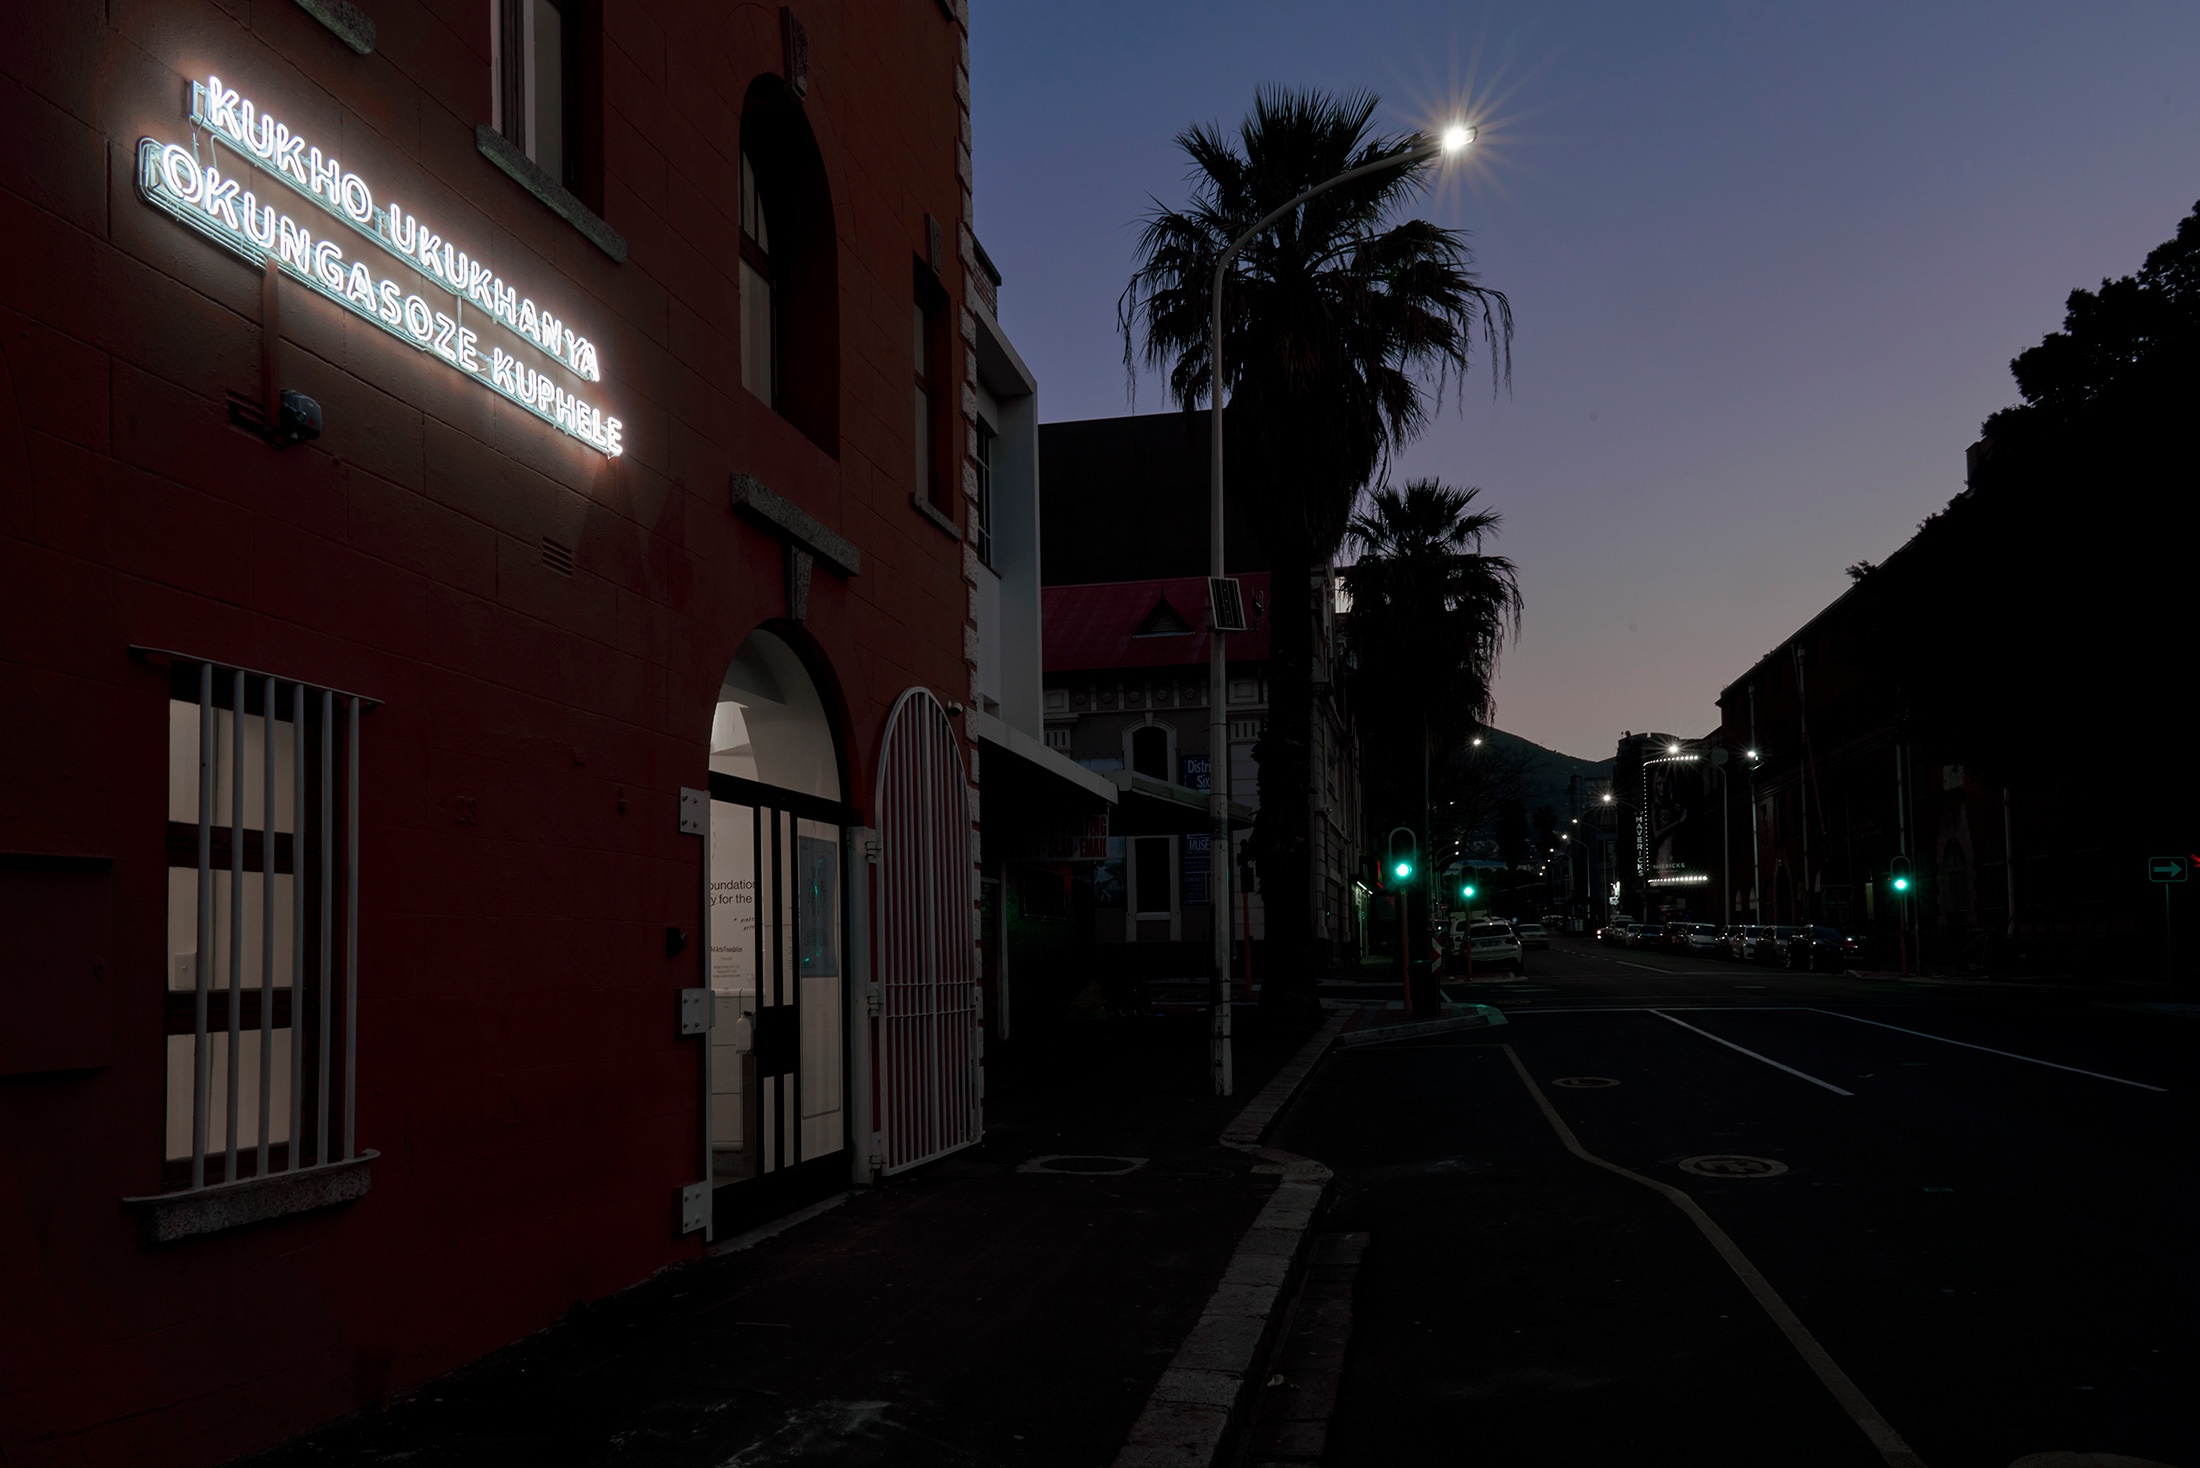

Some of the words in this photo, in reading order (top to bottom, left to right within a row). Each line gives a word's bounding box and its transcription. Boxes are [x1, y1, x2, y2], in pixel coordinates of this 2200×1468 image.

[208, 75, 373, 224] KUKHO
[388, 202, 601, 382] UKUKHANYA
[162, 143, 480, 373] OKUNGASOZE
[491, 347, 624, 457] KUPHELE
[1197, 774, 1211, 788] Six
[1635, 816, 1644, 877] MAVERICKS
[718, 893, 734, 904] for
[735, 893, 753, 904] the
